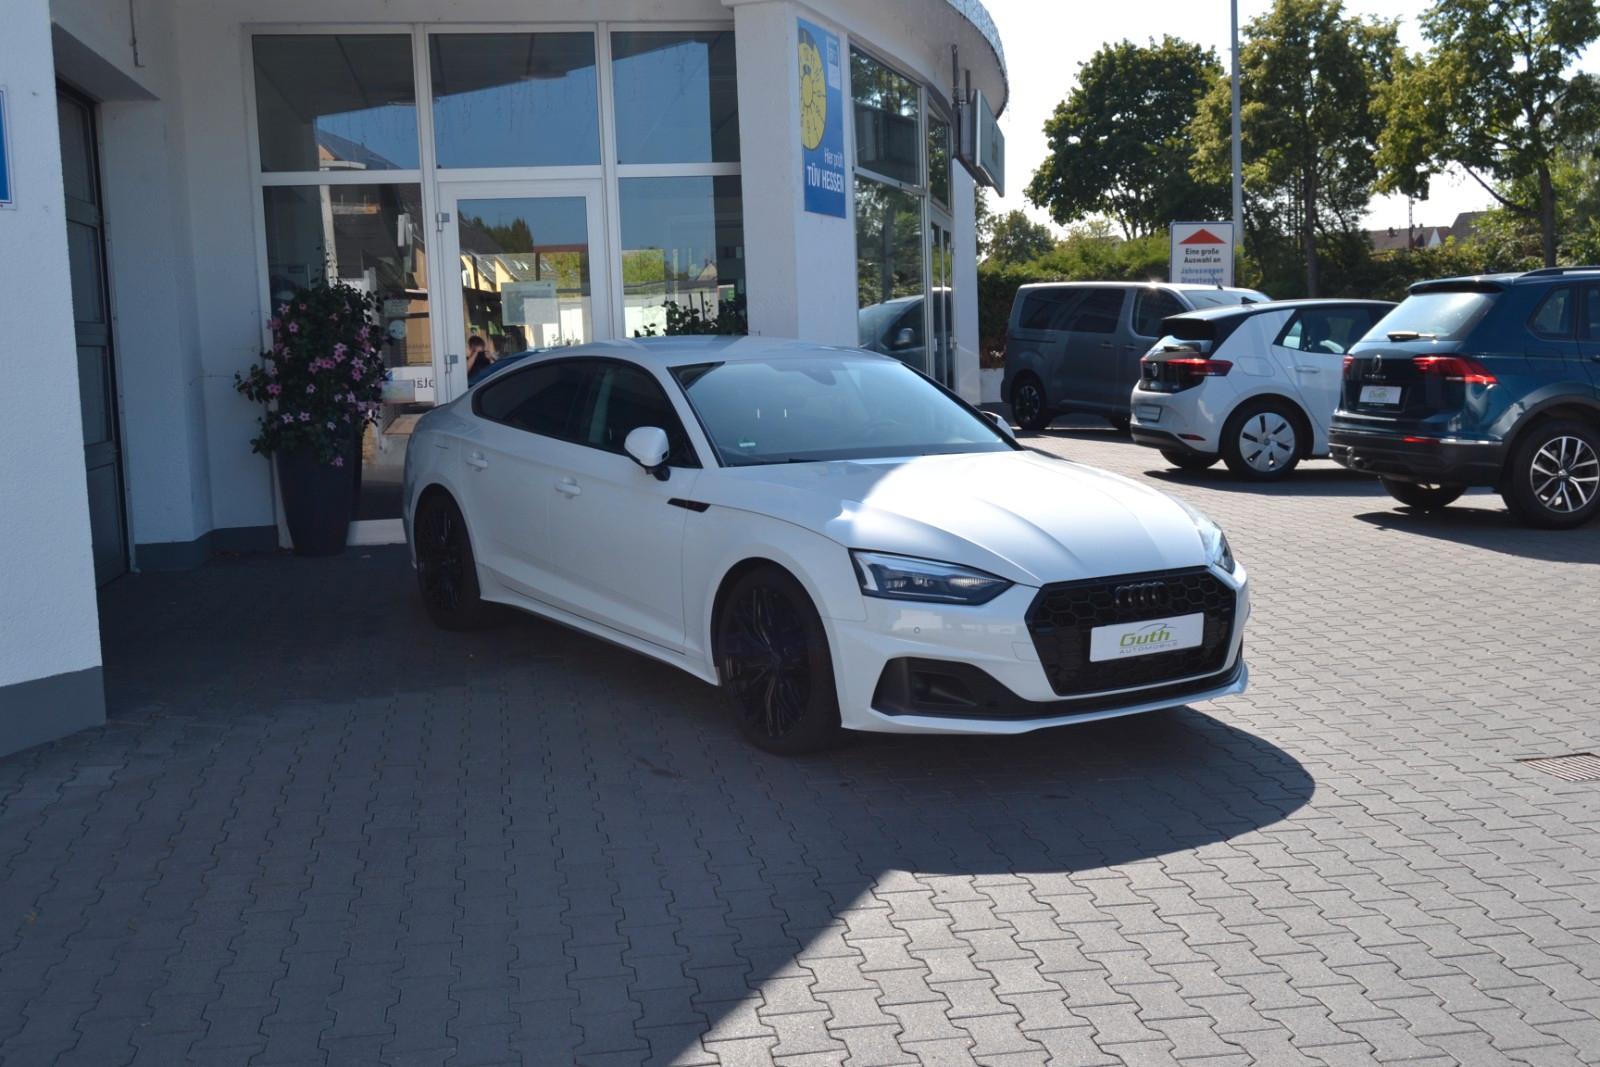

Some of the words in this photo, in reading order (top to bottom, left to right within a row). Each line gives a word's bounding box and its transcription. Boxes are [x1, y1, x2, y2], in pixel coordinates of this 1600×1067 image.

[807, 162, 820, 187] TÜV
[821, 169, 844, 193] HESSEN
[1201, 247, 1219, 256] große
[1120, 628, 1170, 647] Guth
[1120, 641, 1177, 653] AUTOMOBILE
